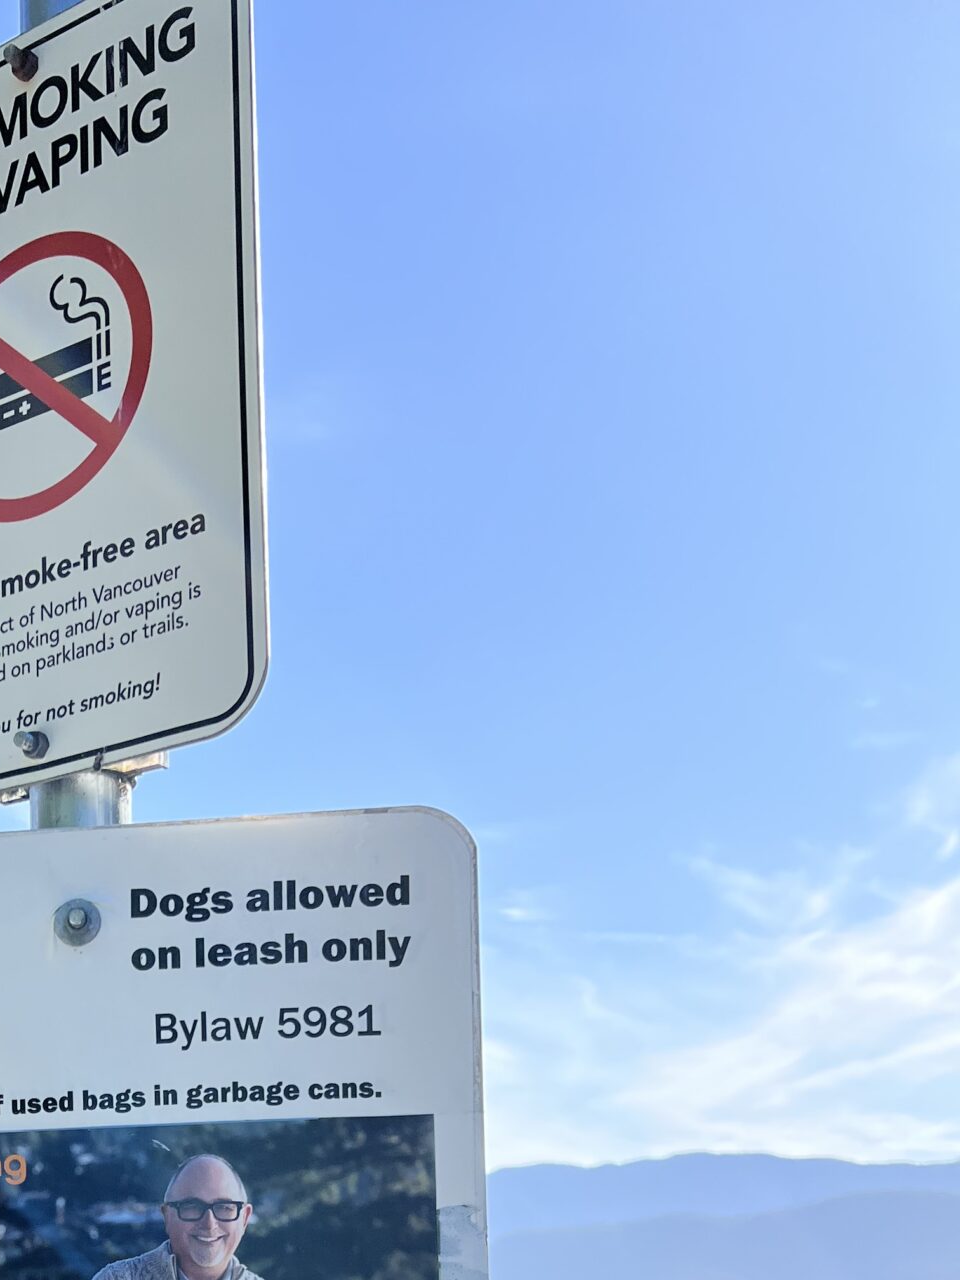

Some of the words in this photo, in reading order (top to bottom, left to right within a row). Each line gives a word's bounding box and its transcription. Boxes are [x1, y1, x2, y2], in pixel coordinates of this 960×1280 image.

[144, 512, 206, 551] area
[19, 607, 37, 628] of
[40, 592, 88, 622] North
[91, 564, 182, 604] Vancouver
[64, 609, 121, 640] and/or
[125, 589, 184, 626] vaping
[187, 582, 202, 601] is
[10, 661, 32, 679] on
[35, 636, 115, 676] parklands
[119, 628, 138, 646] or
[141, 613, 190, 640] trails.
[15, 706, 41, 734] for
[45, 700, 75, 723] not
[79, 672, 161, 713] smoking!
[130, 887, 234, 922] Dogs
[246, 875, 410, 912] allowed
[131, 946, 181, 971] on
[195, 933, 308, 968] leash
[321, 929, 411, 968] only
[155, 1011, 264, 1051] Bylaw
[277, 1004, 381, 1039] 5981
[11, 1090, 74, 1115] used
[82, 1088, 147, 1114] bags
[154, 1084, 178, 1106] in
[186, 1080, 300, 1109] garbage
[308, 1081, 382, 1100] cans.
